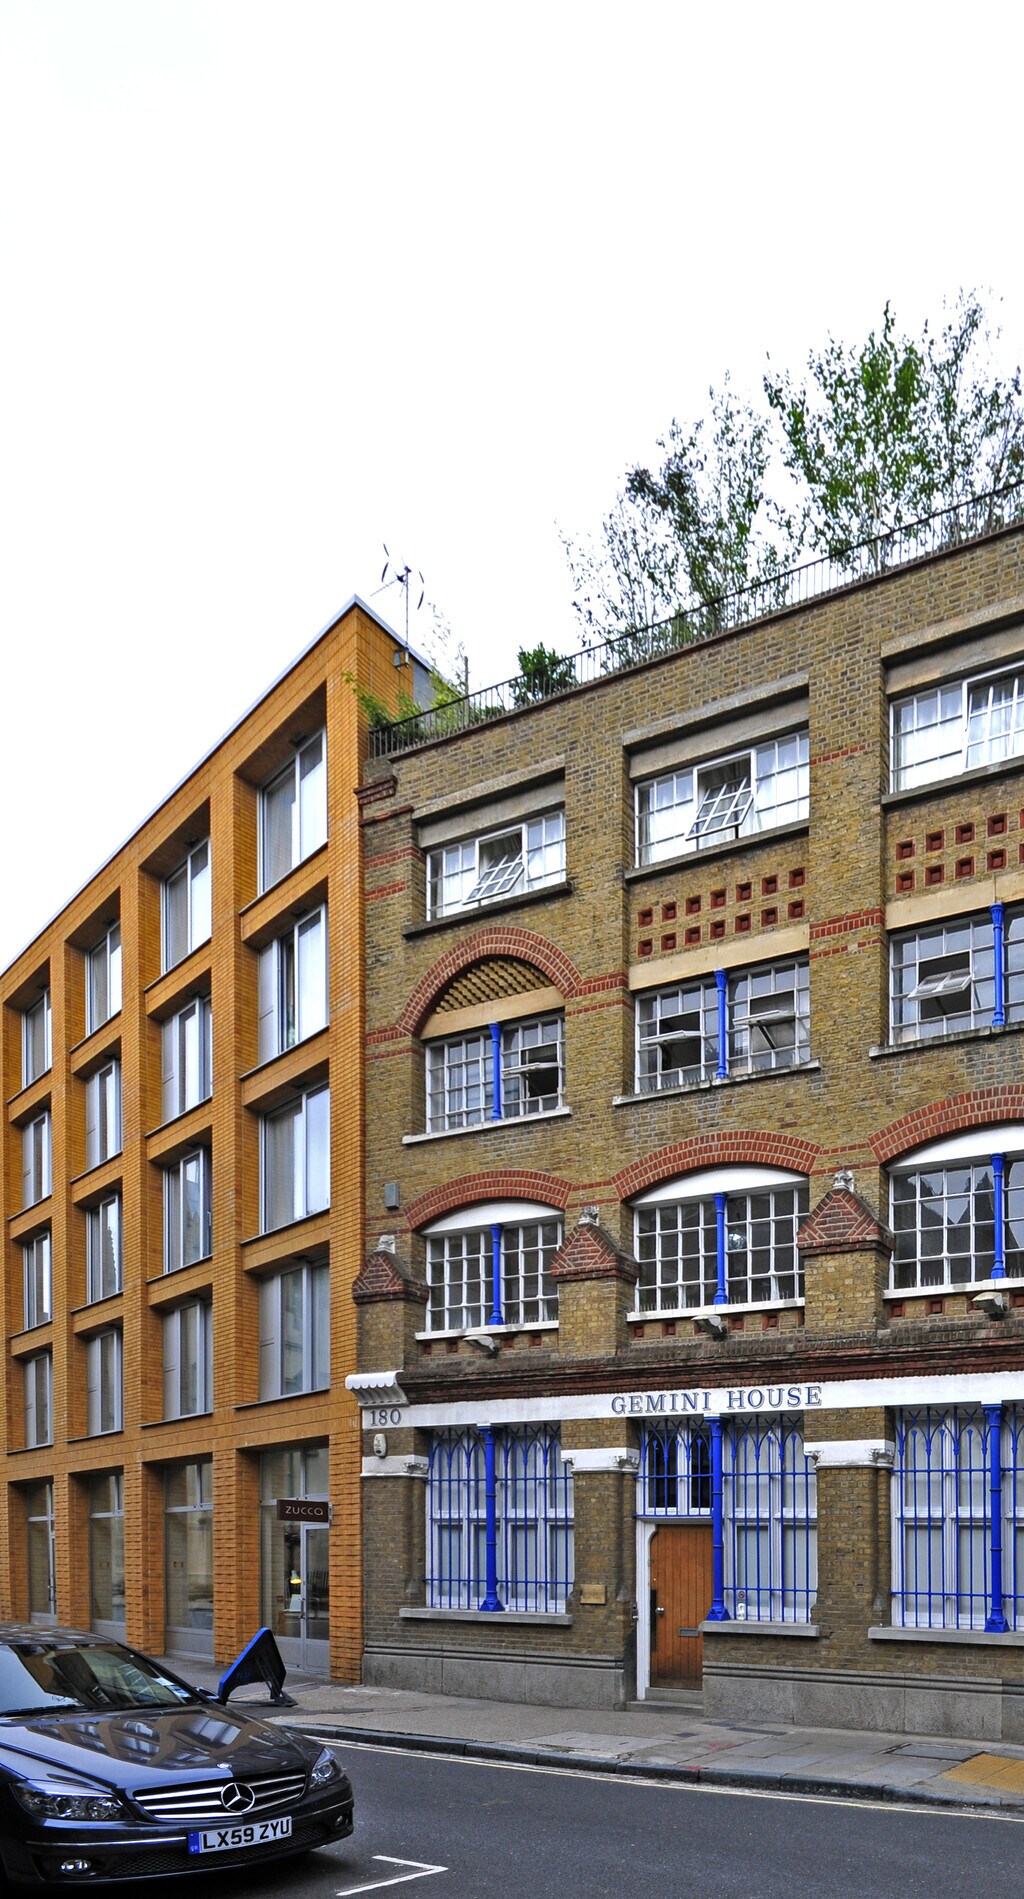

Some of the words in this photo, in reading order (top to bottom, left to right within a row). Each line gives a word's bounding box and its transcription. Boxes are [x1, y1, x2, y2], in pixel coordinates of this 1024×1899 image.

[611, 1392, 711, 1415] GEMINI
[726, 1386, 822, 1409] HOUSE
[370, 1408, 402, 1426] 180
[203, 1827, 254, 1850] LX59
[260, 1819, 290, 1840] ZYU
